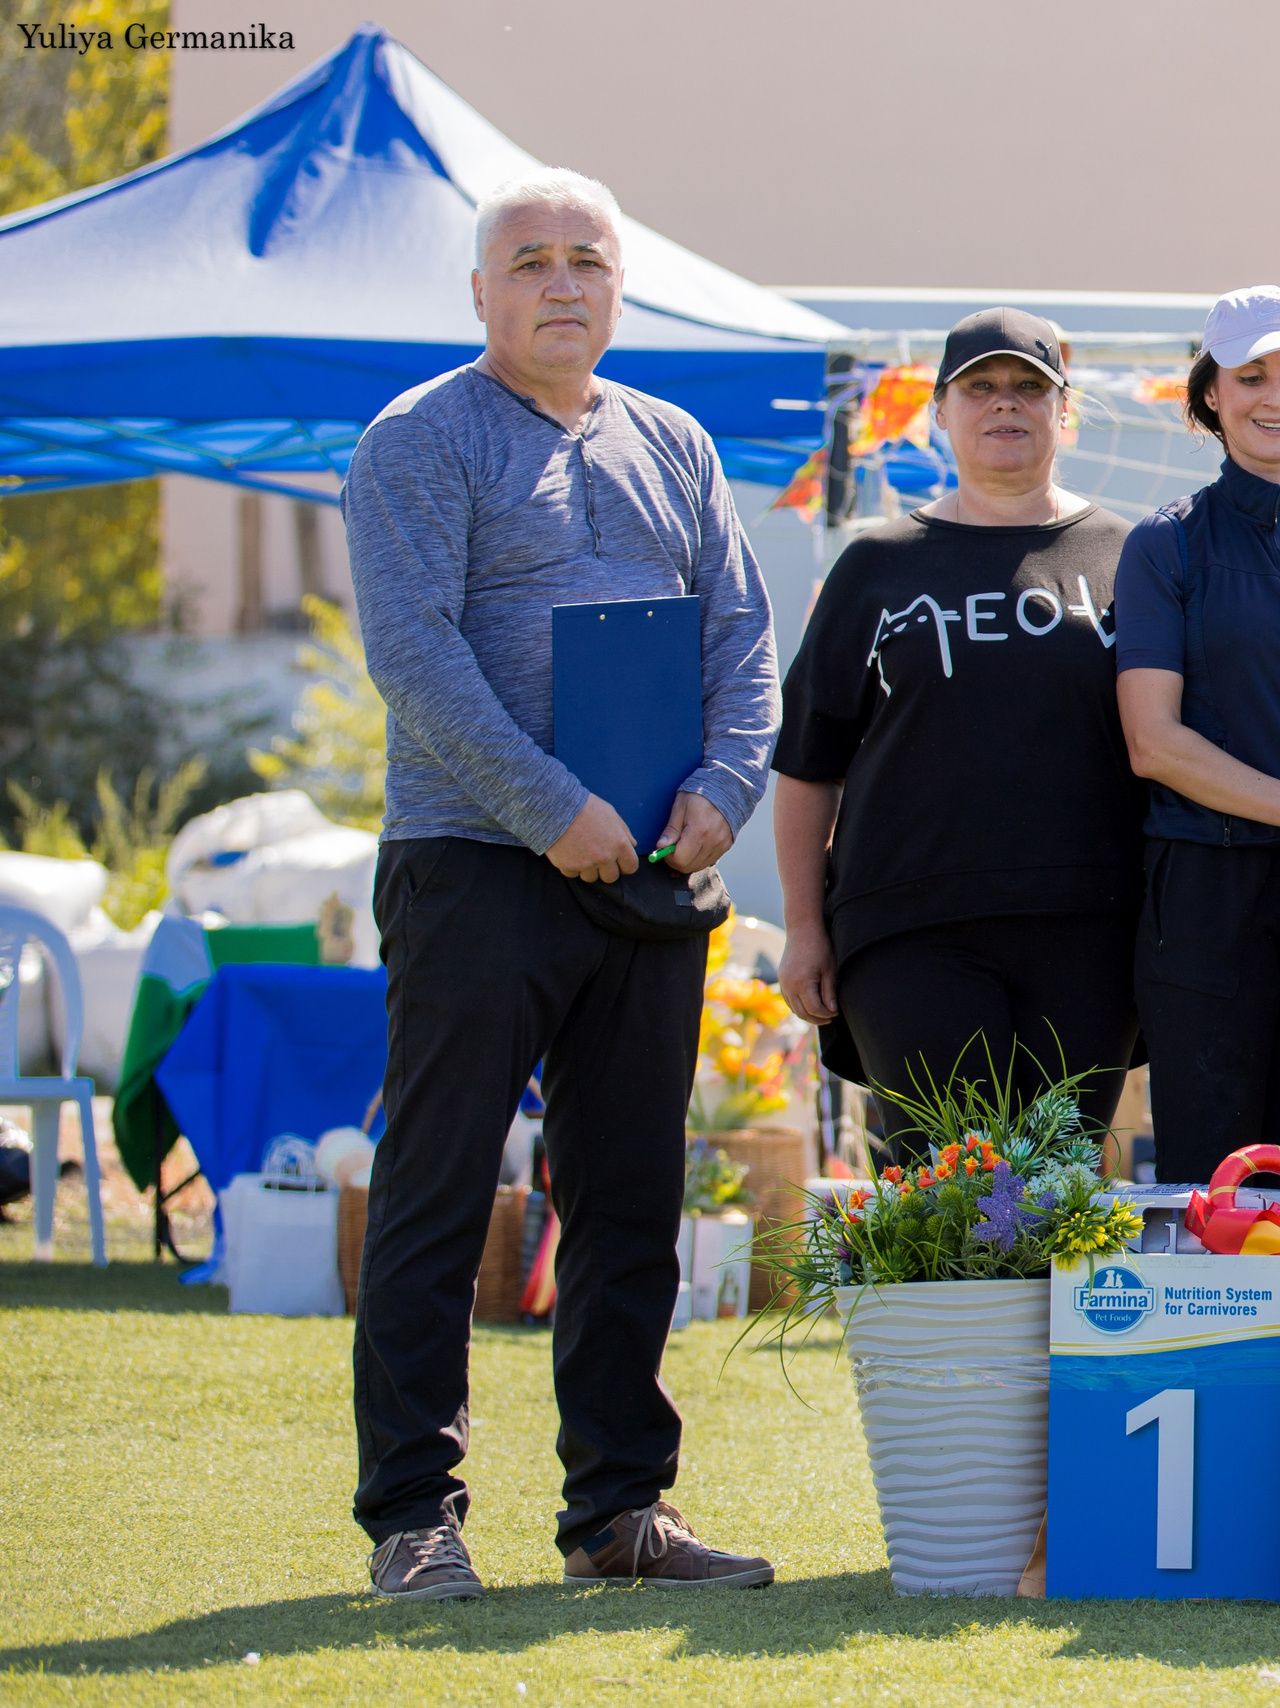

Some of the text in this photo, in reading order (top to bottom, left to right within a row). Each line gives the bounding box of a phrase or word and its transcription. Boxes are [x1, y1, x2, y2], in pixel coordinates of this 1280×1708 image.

[1079, 1290, 1148, 1308] Farmina
[1164, 1287, 1273, 1303] Nutrition System
[1164, 1302, 1258, 1316] for Carnivores
[1095, 1313, 1132, 1322] Pet Foods
[1126, 1388, 1196, 1570] 1
